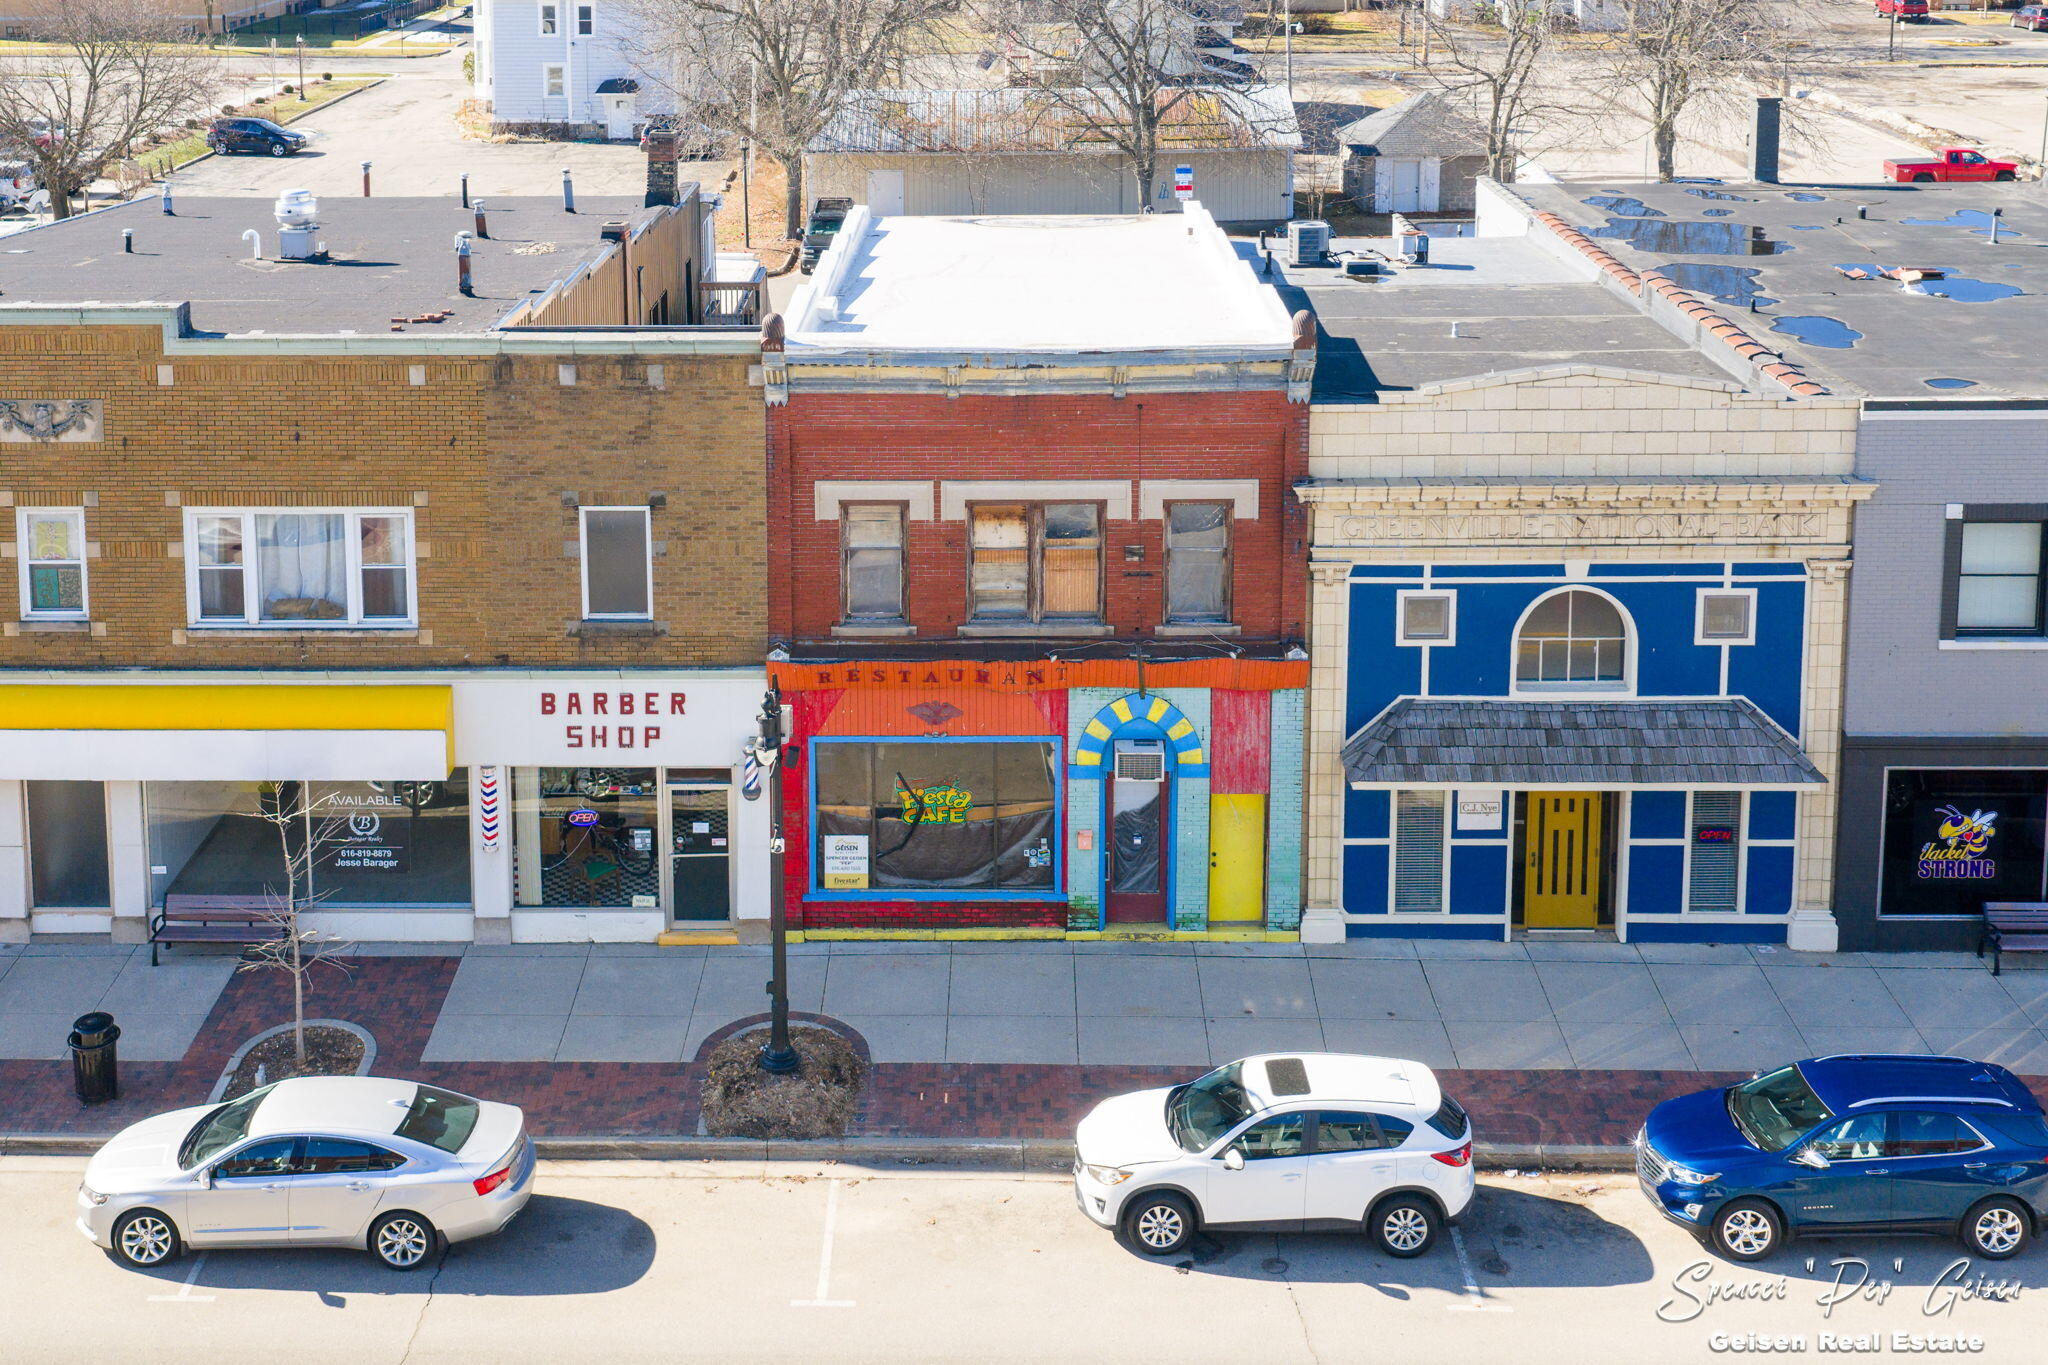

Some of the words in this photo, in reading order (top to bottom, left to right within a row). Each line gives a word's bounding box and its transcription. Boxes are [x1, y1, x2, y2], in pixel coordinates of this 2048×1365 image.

[817, 667, 1069, 686] RESTAURANT
[541, 692, 686, 715] BARBER
[566, 725, 661, 749] SHOP
[328, 795, 402, 806] AVAILABLE
[568, 813, 600, 824] OPEN
[1698, 830, 1731, 840] OPEN
[341, 849, 392, 858] 616-819-8879
[1920, 843, 1970, 860] Jacket
[335, 858, 362, 867] Jesse
[363, 859, 398, 868] Barager
[1918, 859, 1995, 878] STRONG
